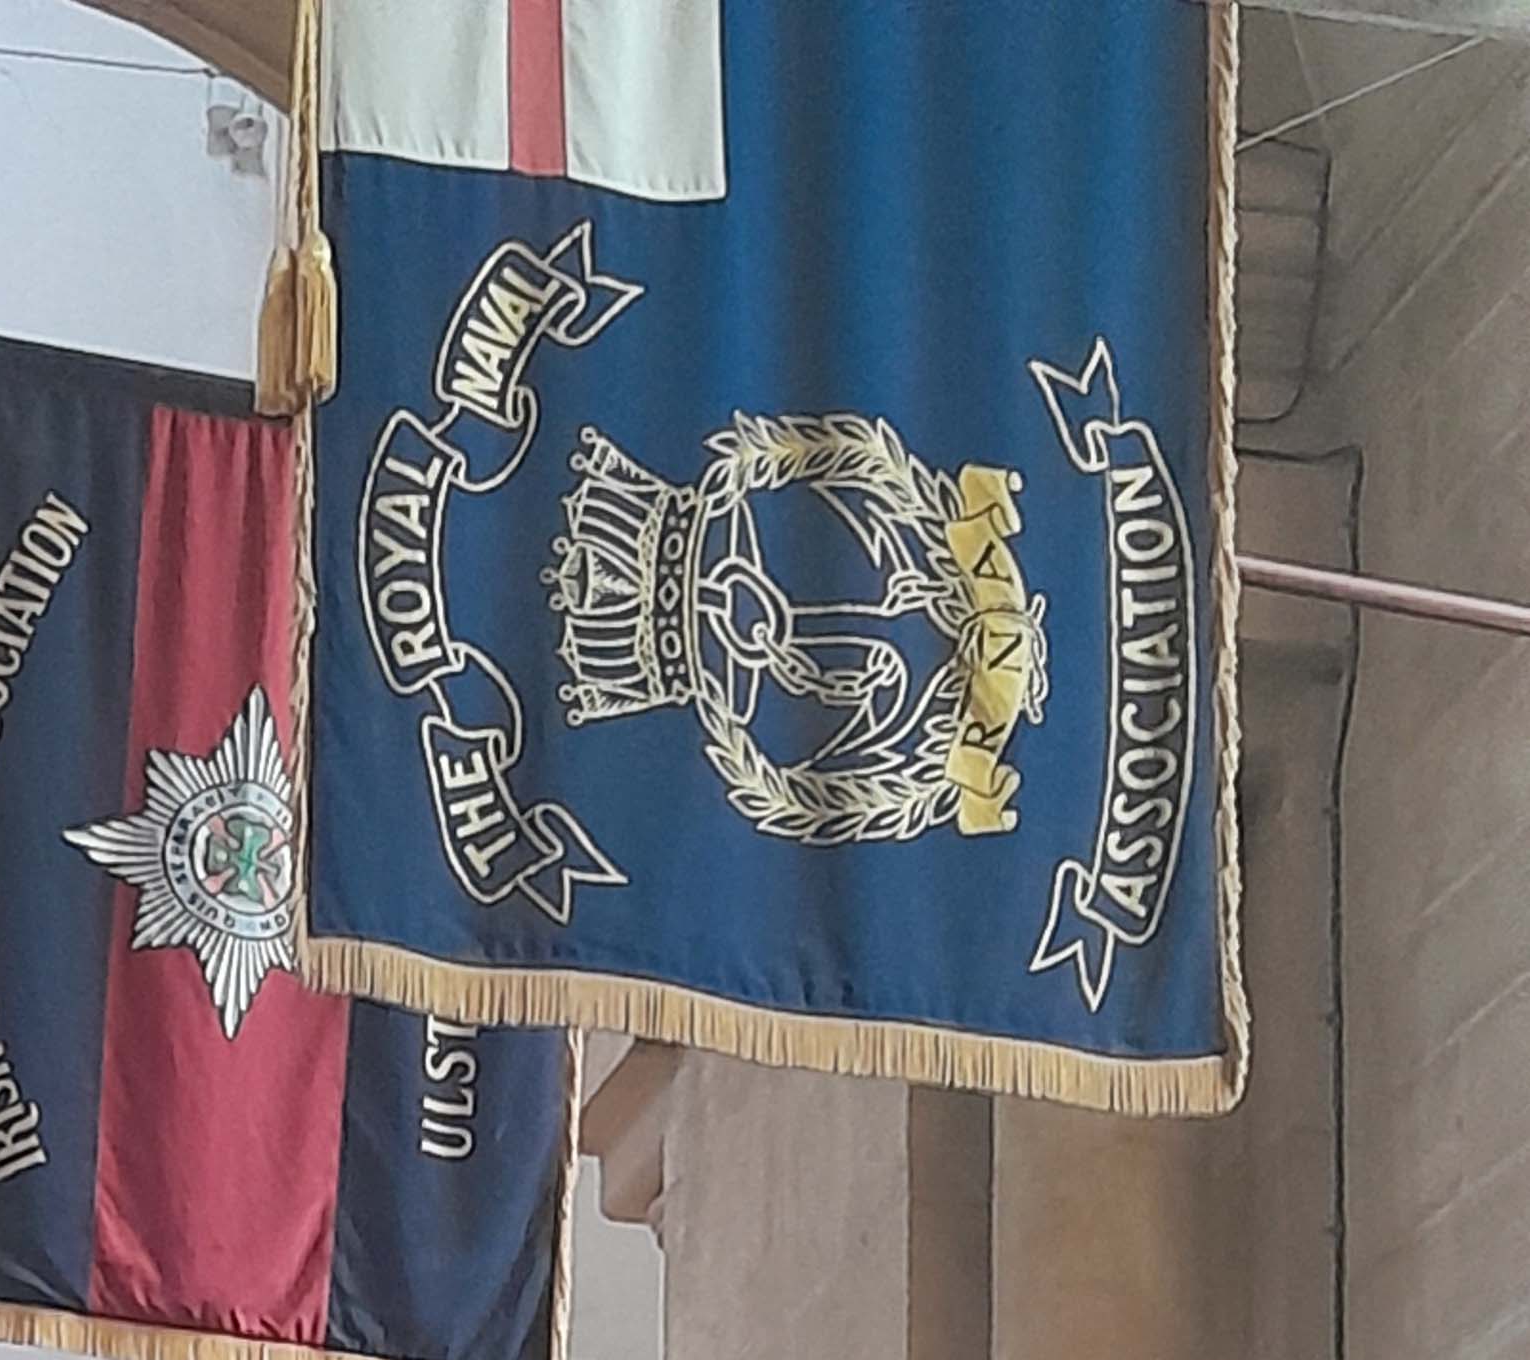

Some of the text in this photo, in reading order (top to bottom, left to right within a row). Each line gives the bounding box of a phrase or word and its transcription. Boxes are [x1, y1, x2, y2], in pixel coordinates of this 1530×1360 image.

[377, 266, 561, 879] THE ROYAL NAVAL
[1095, 463, 1182, 917] ASSOCIATION
